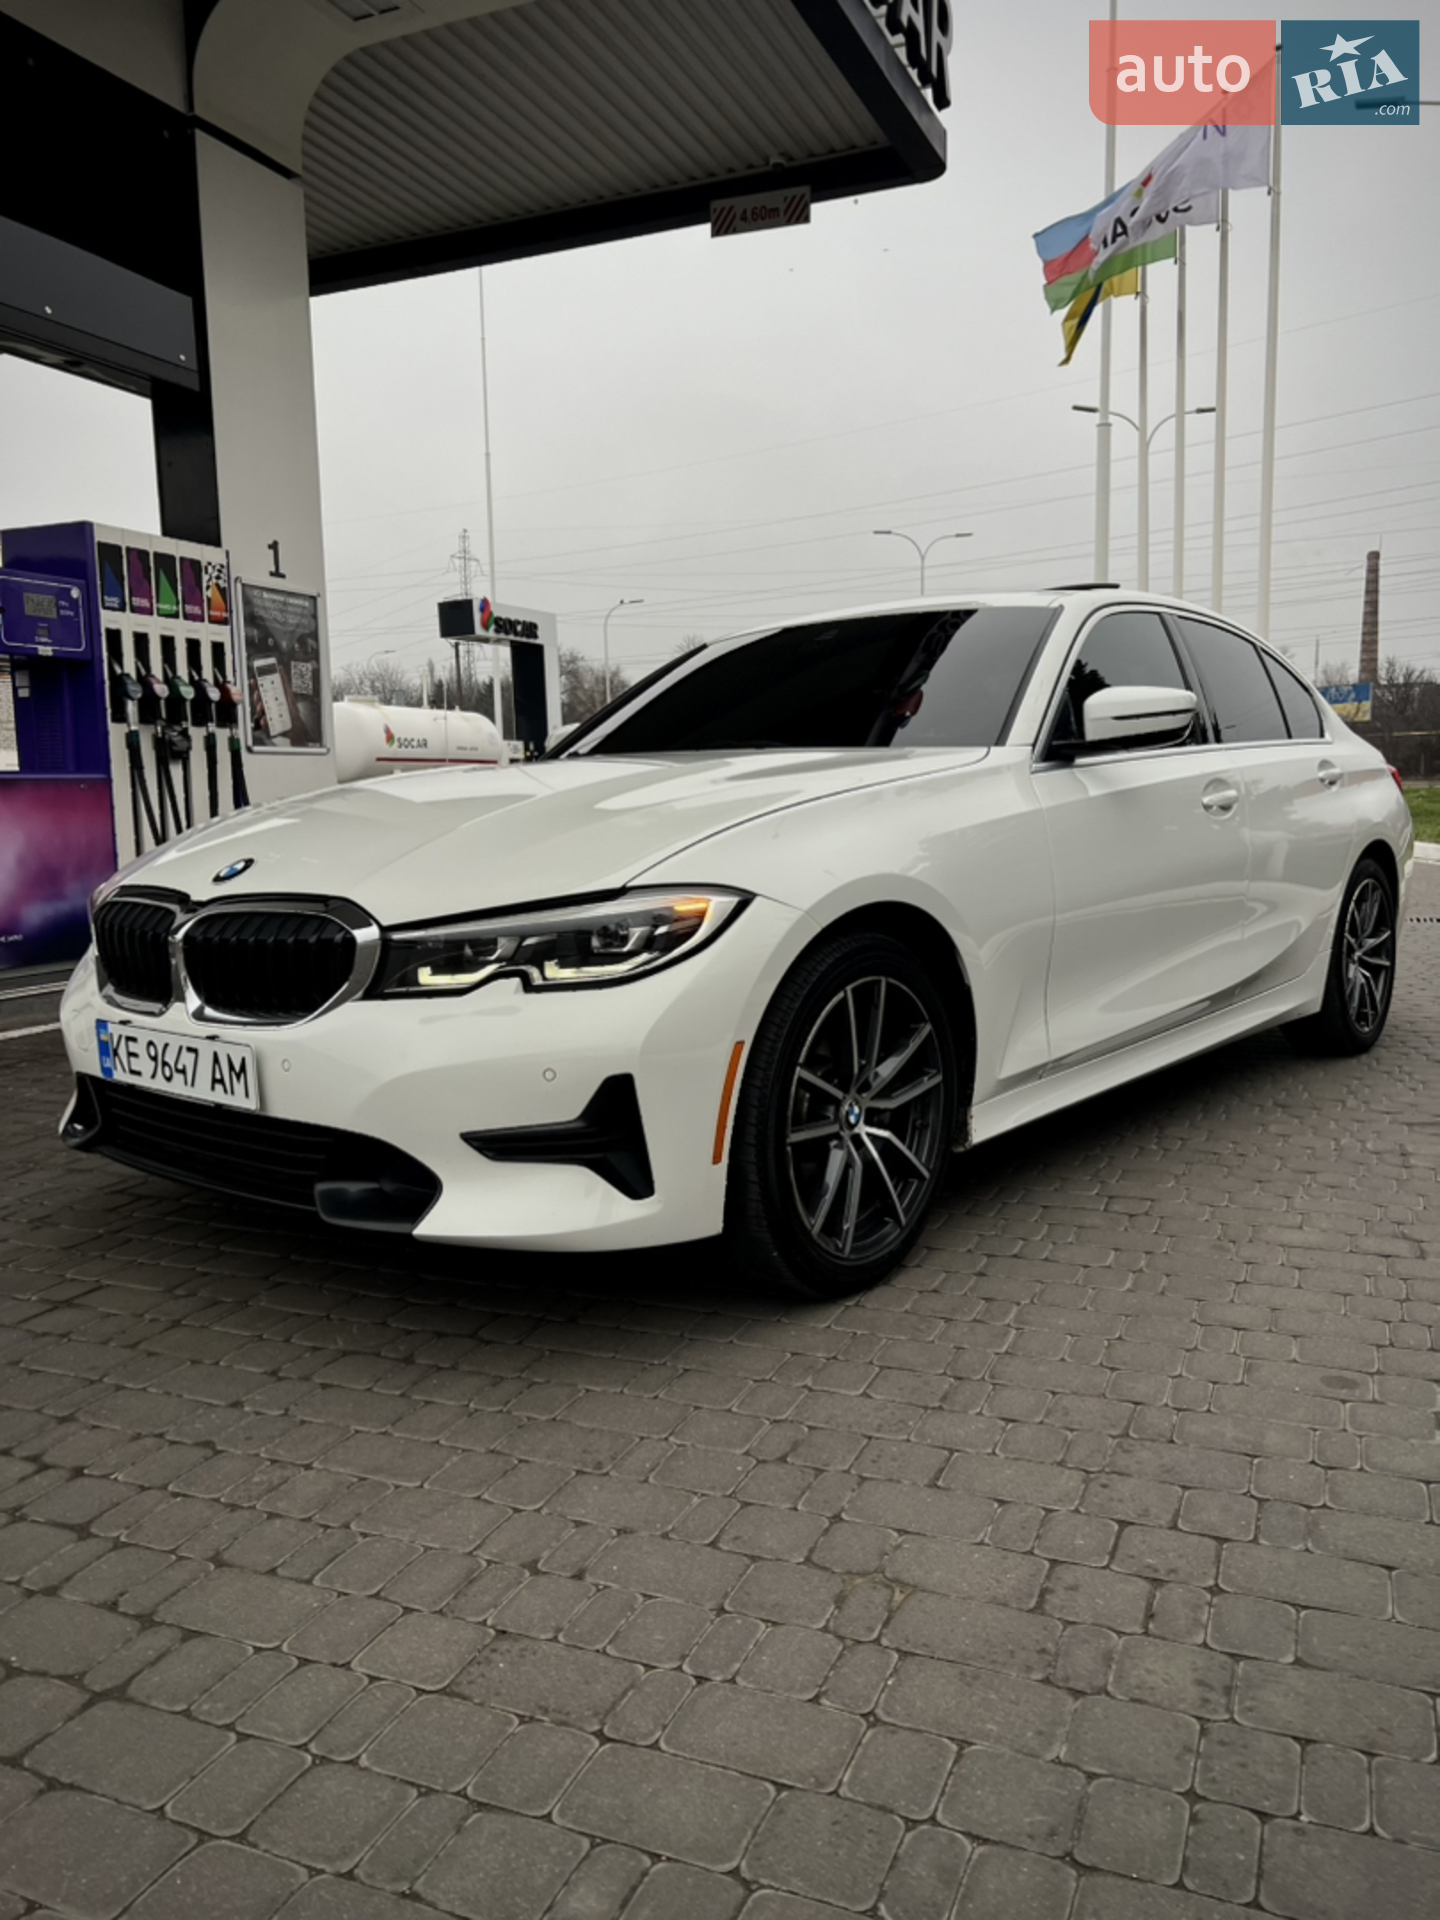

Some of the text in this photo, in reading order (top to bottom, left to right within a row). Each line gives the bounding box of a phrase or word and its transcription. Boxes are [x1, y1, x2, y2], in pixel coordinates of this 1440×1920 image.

[267, 540, 286, 578] 1
[494, 615, 539, 639] SOCAR
[396, 737, 429, 749] SOCAR
[110, 1033, 251, 1099] KE 9647 AM
